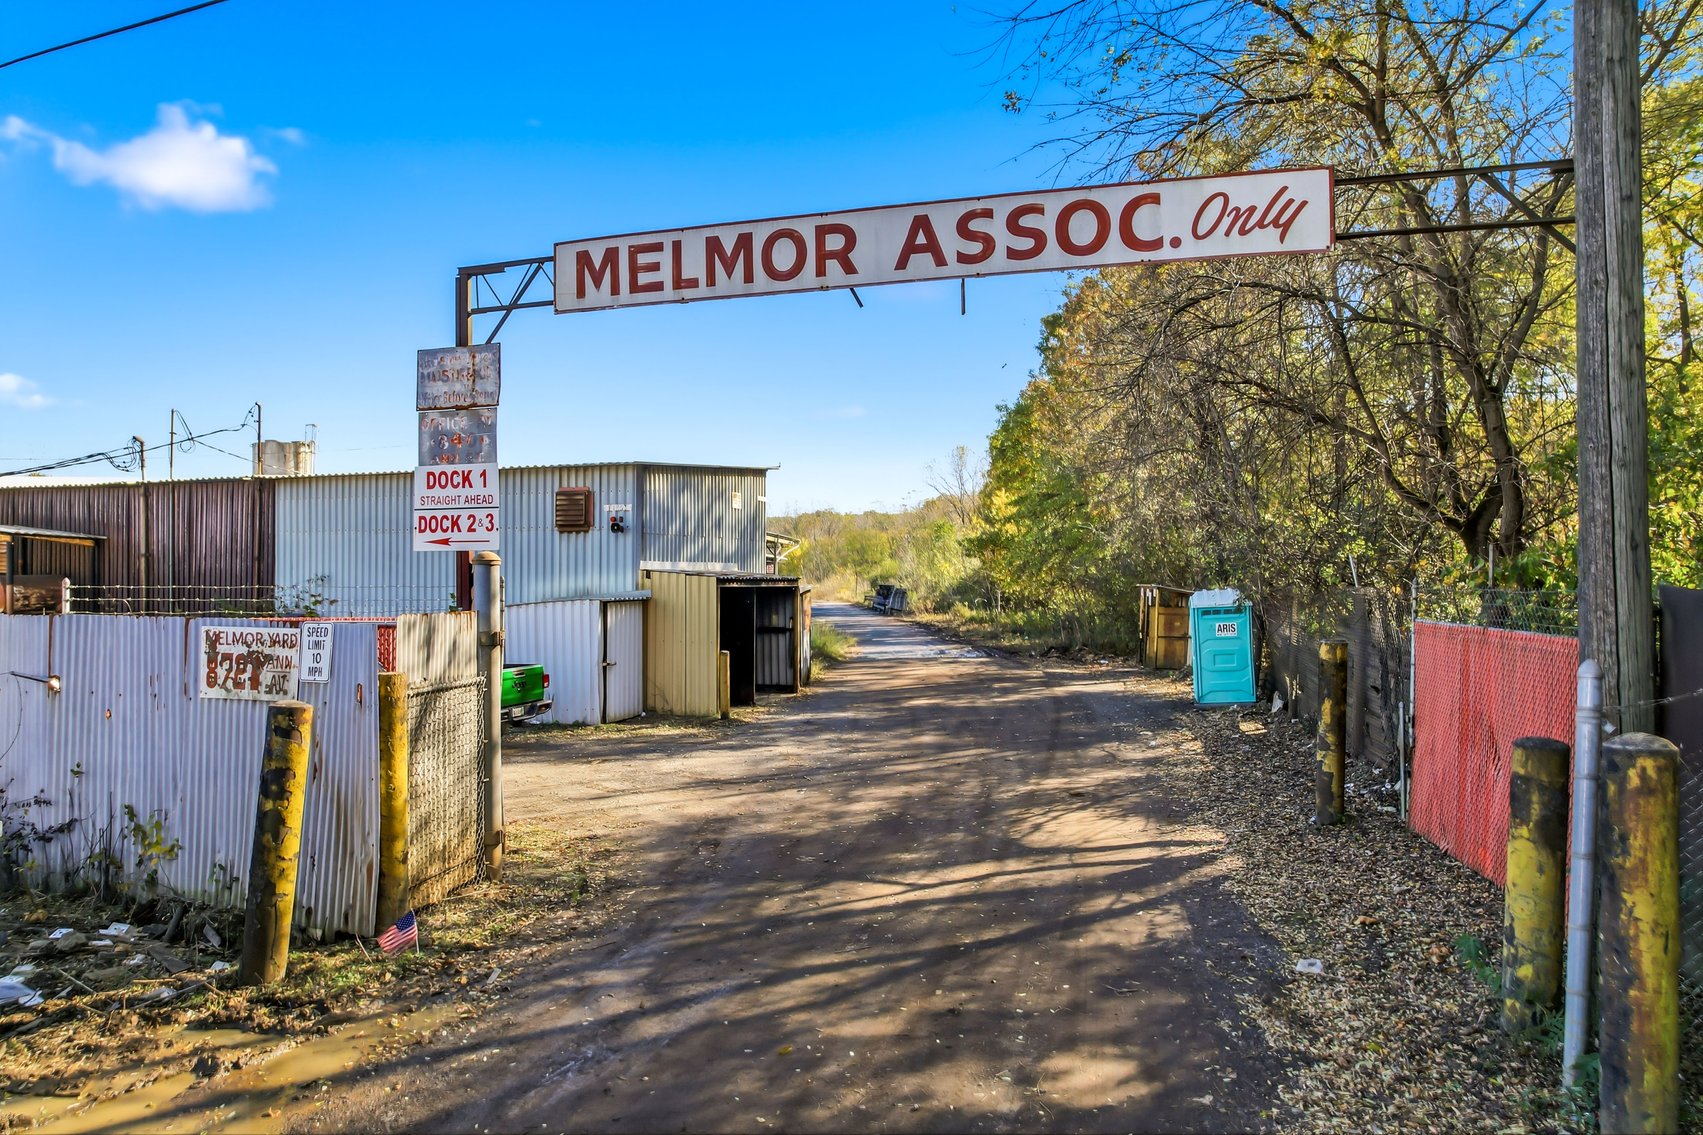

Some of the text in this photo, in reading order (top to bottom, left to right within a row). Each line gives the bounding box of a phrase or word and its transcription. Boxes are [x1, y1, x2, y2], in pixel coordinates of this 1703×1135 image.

[576, 185, 1310, 300] MELMOR ASSOC. Only
[426, 469, 487, 490] DOCK 1
[420, 494, 494, 506] STRAIGHT AHEAD
[418, 514, 462, 533] DOCK
[307, 626, 329, 638] SPEED
[1217, 623, 1236, 633] ARIS
[205, 629, 298, 650] MELMOR YARD
[307, 640, 326, 651] LIMIT
[311, 653, 322, 665] 10
[307, 666, 323, 678] MPH
